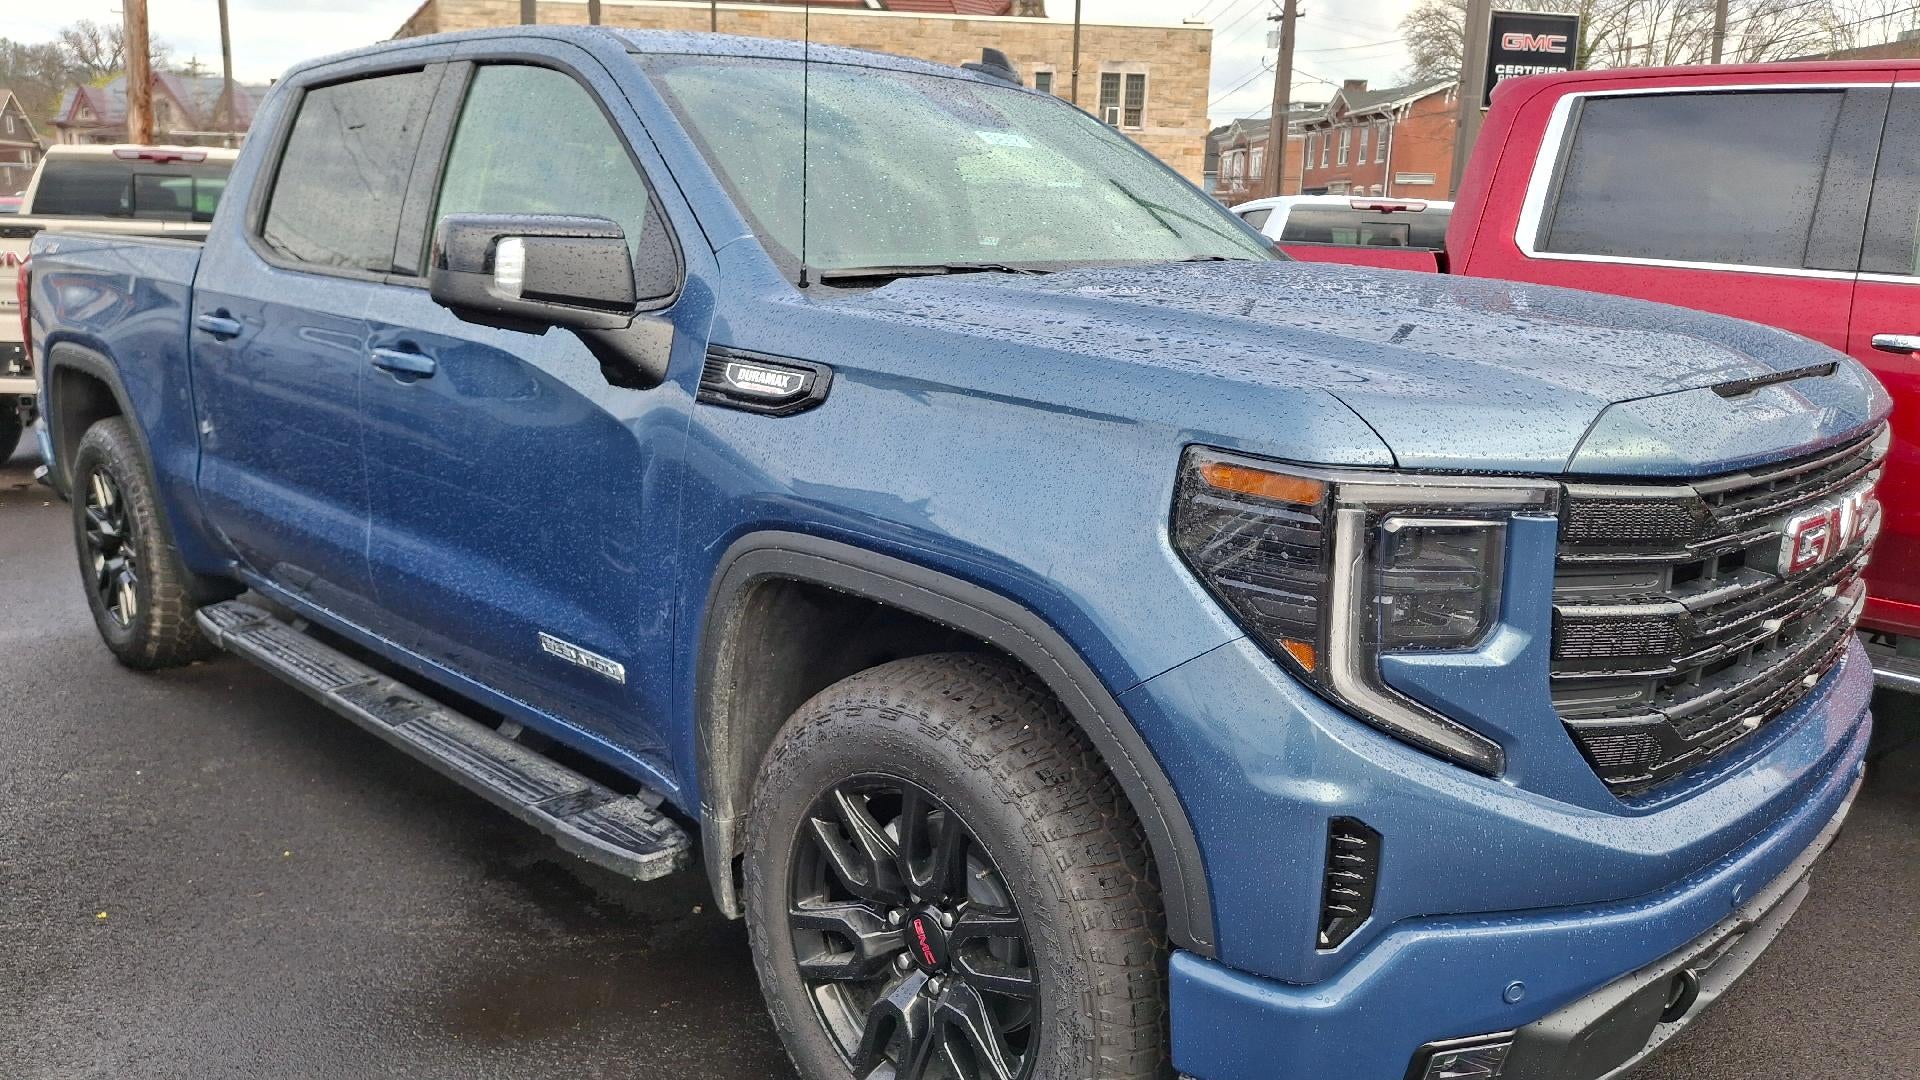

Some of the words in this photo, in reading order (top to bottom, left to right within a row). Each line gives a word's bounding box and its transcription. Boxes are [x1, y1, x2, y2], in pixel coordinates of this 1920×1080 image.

[1502, 33, 1567, 53] GMC
[1495, 64, 1567, 76] CERTIFIED
[737, 368, 791, 388] DURAMAX
[913, 918, 937, 965] GMC
